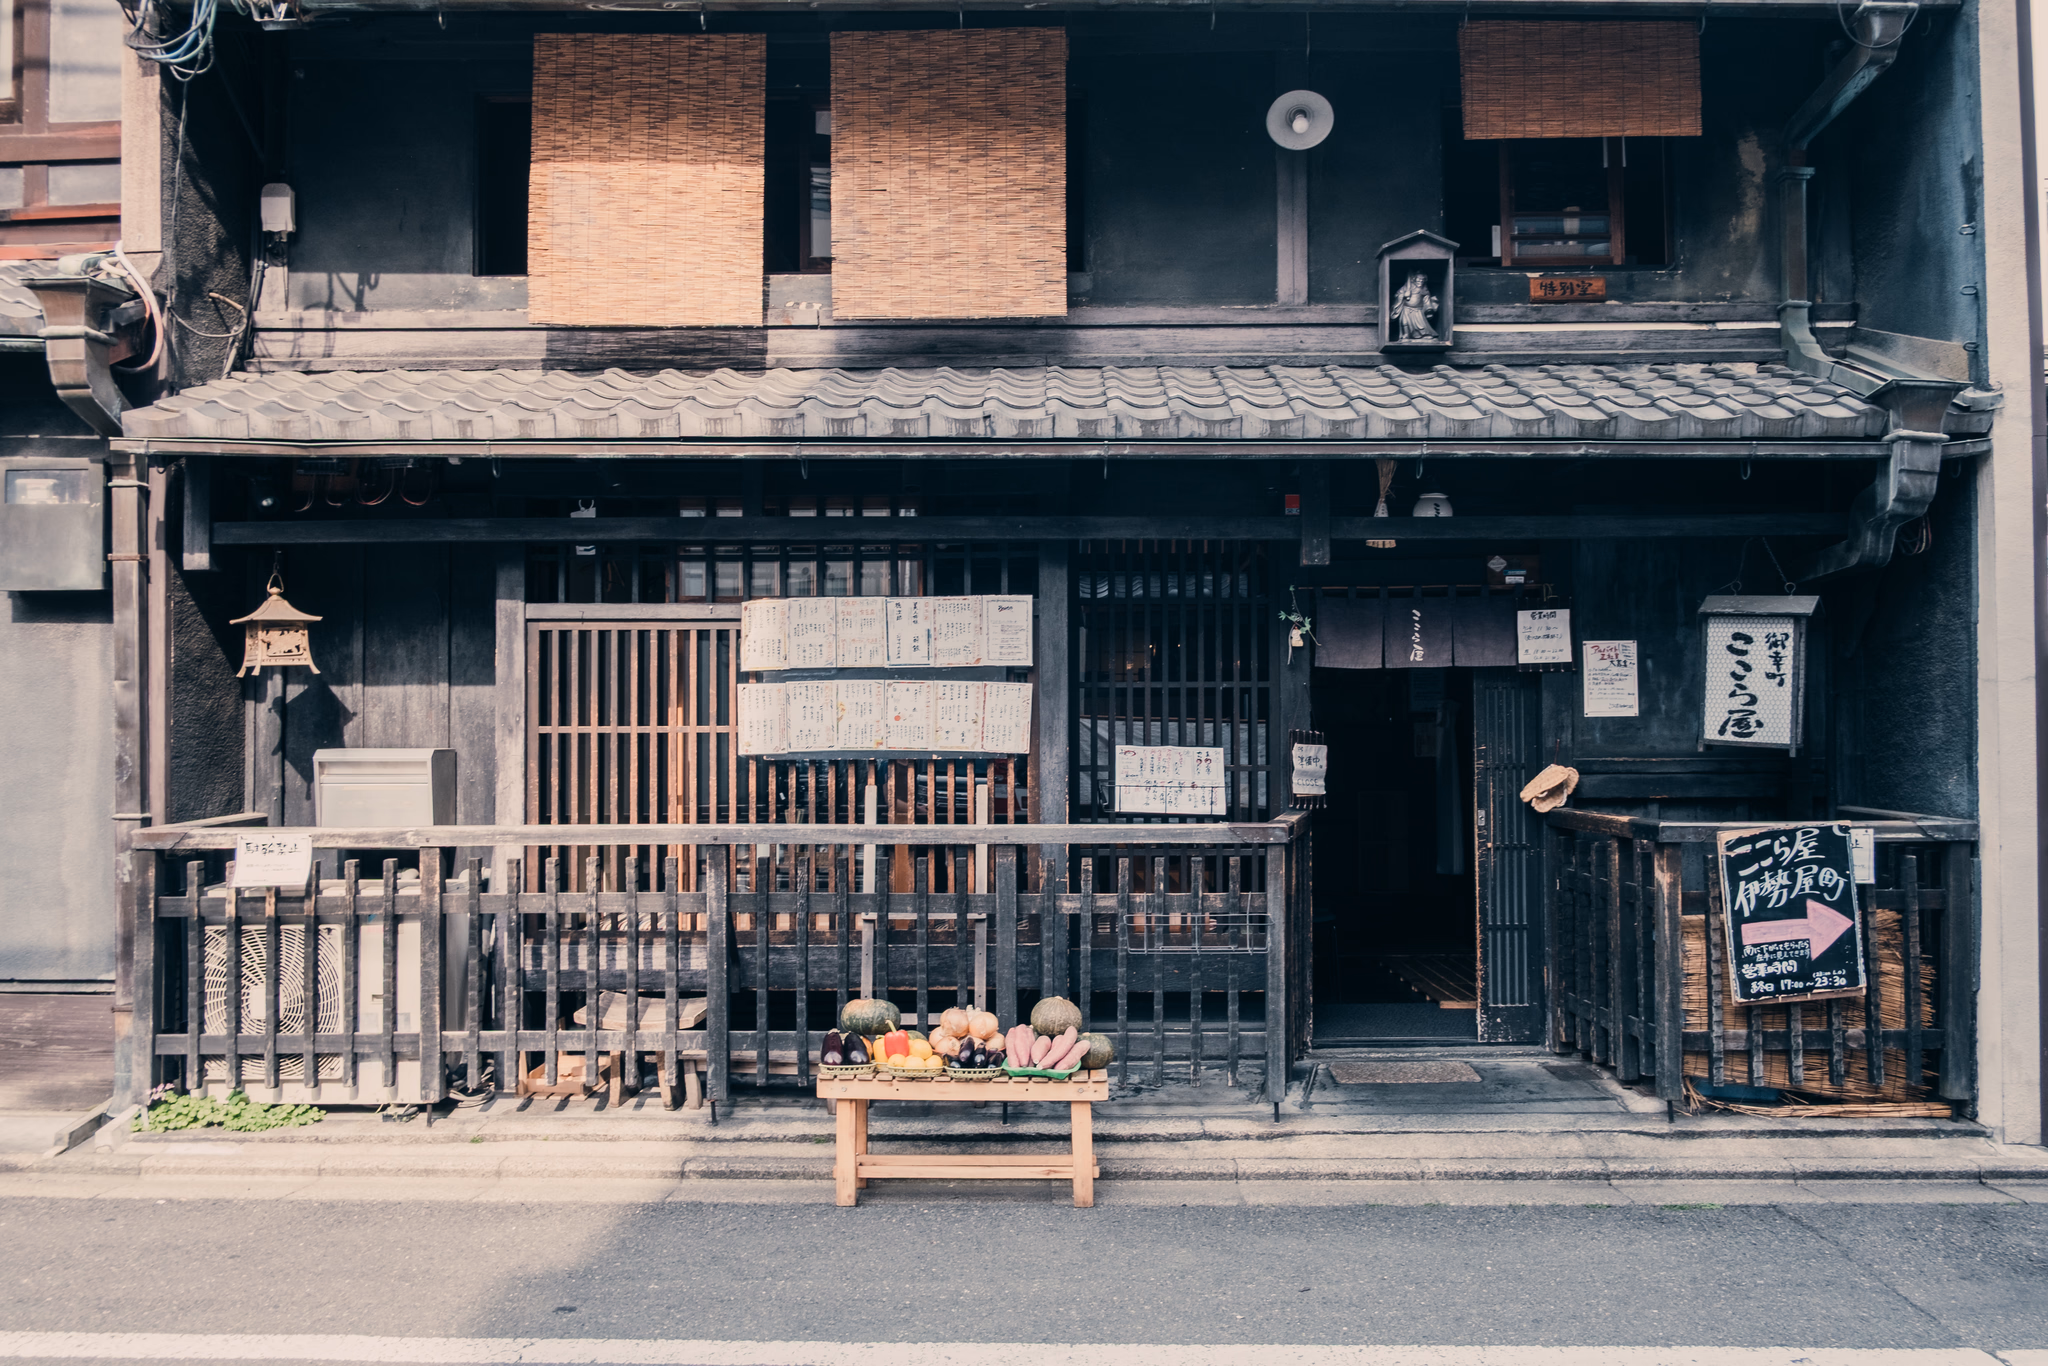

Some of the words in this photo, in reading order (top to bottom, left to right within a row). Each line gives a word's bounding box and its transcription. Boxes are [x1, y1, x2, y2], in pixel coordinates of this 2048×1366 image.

[1540, 281, 1596, 296] 特別室
[1765, 632, 1789, 687] 御幸町
[1718, 632, 1764, 738] ここら屋
[1297, 778, 1319, 787] CLOSE
[244, 842, 301, 856] 駐輪禁止
[1731, 828, 1826, 877] ここら屋
[1734, 864, 1848, 917] 伊勢屋町
[1741, 959, 1797, 979] 営業時間
[1750, 981, 1775, 994] 終日
